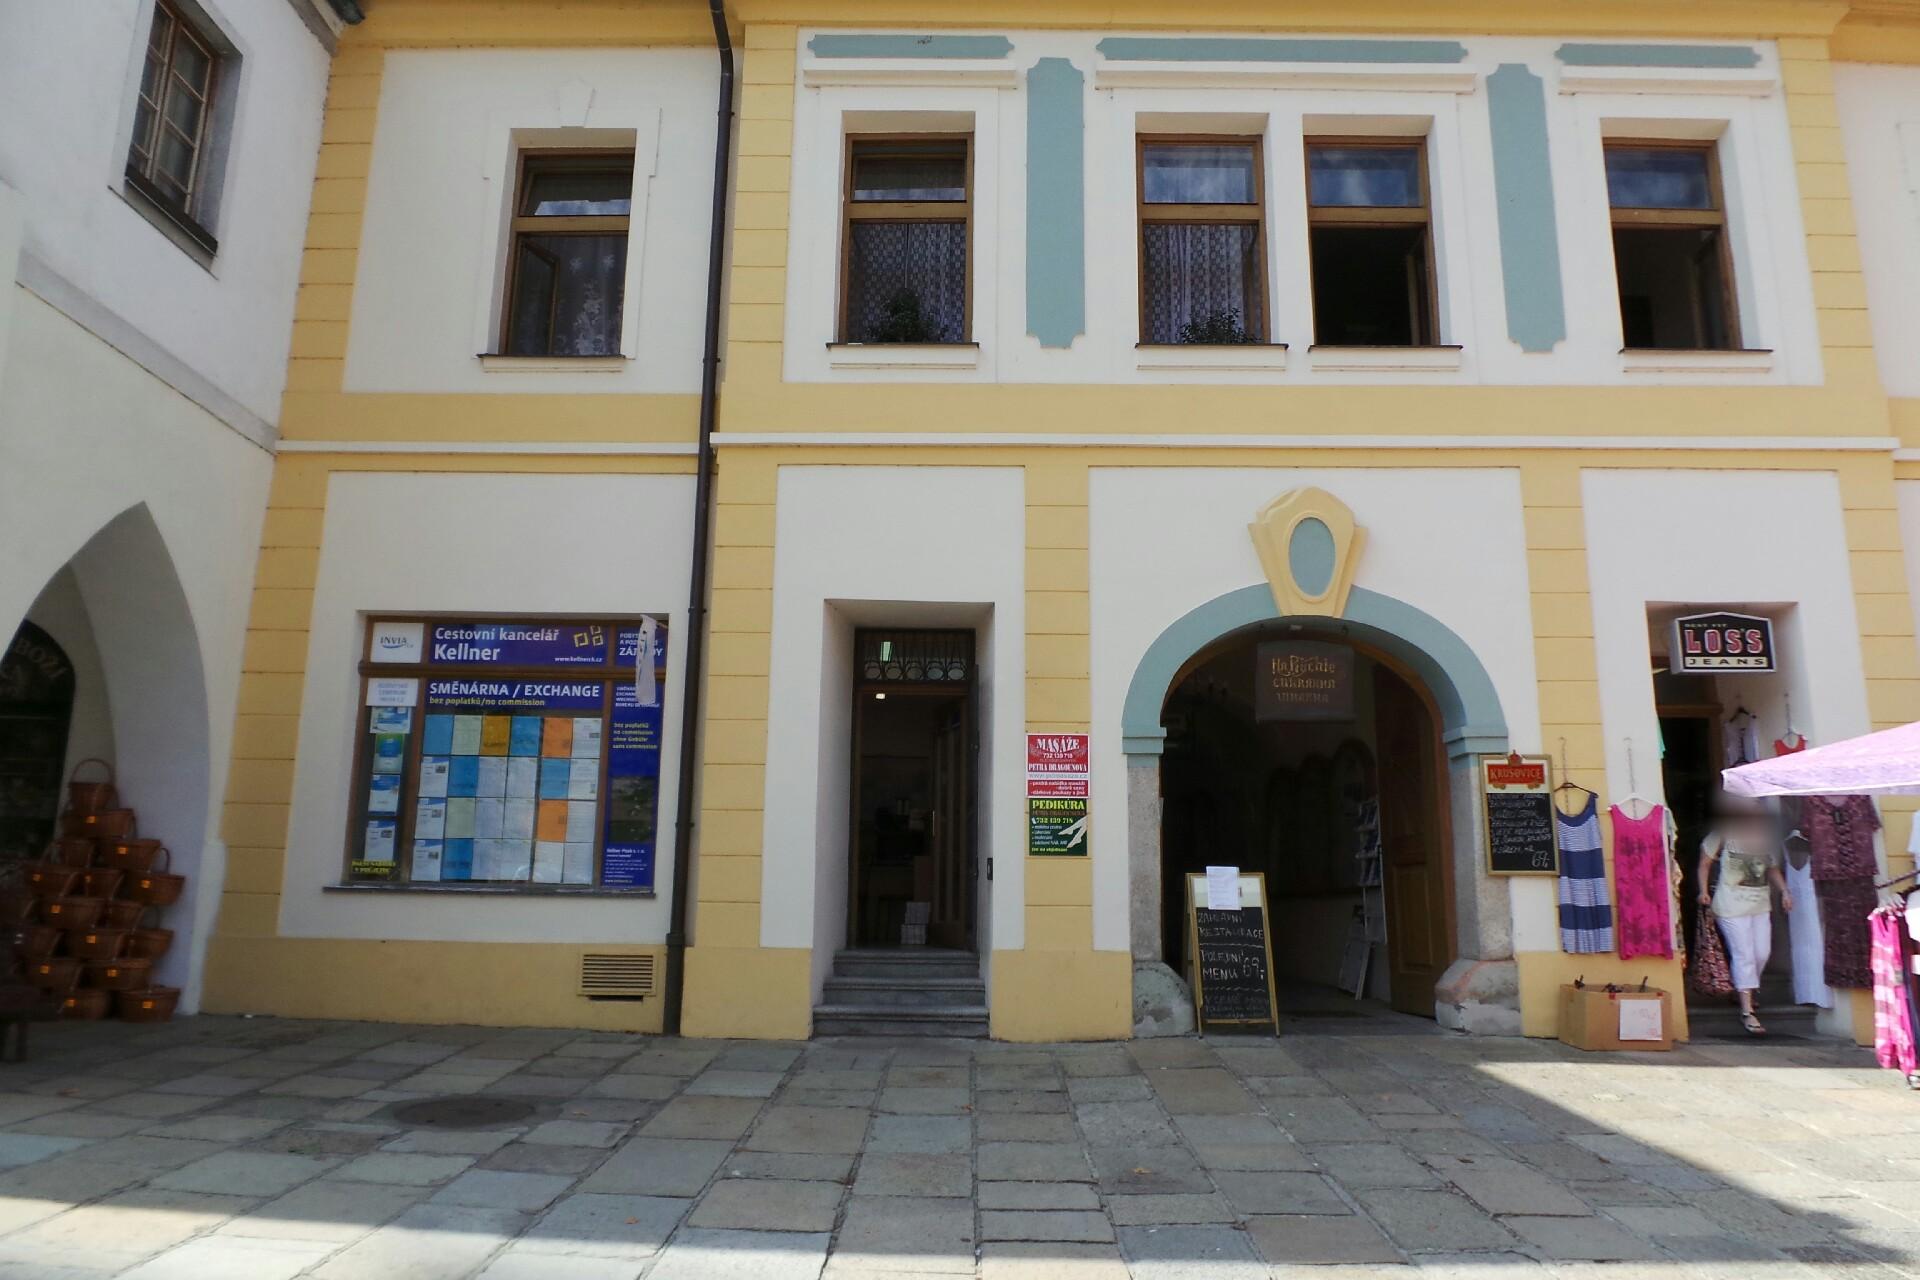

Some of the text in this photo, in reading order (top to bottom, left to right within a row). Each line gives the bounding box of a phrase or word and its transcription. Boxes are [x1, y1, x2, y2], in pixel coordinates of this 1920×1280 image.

[435, 627, 560, 641] Cestovní kancelář
[434, 643, 501, 660] Kellner
[429, 680, 509, 695] SMĚNÁRNA
[523, 684, 599, 697] EXCHANGE
[429, 696, 443, 705] bez
[497, 698, 545, 706] commission
[1036, 735, 1080, 753] MASÁŽE
[1032, 798, 1085, 810] PEDIKÚRA
